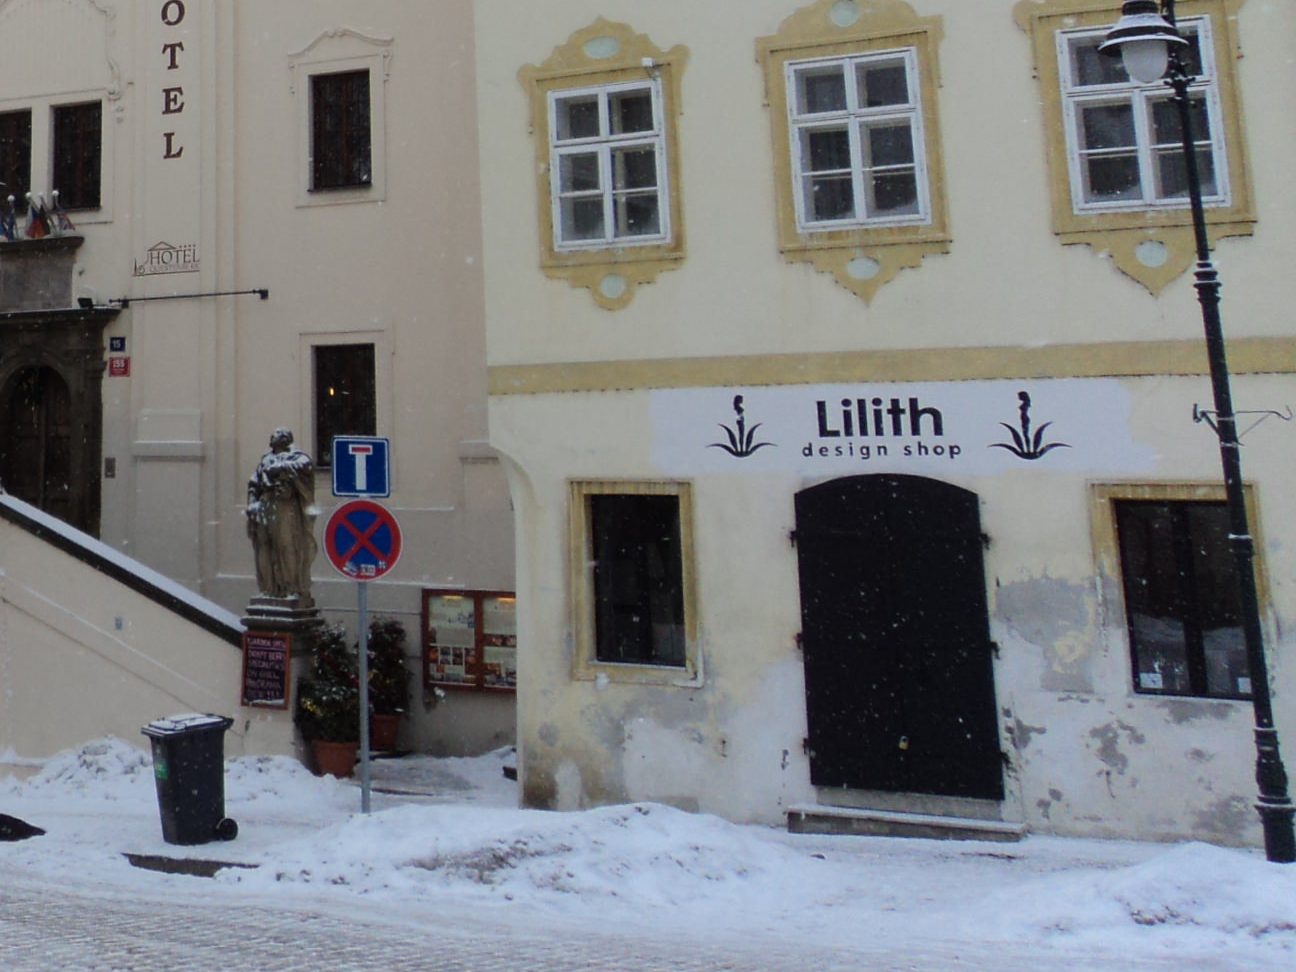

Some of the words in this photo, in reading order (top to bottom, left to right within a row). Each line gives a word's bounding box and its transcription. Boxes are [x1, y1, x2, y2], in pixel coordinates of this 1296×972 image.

[150, 249, 200, 264] HOTEL
[816, 397, 944, 438] Lilith
[802, 442, 888, 460] design
[903, 441, 962, 460] shop
